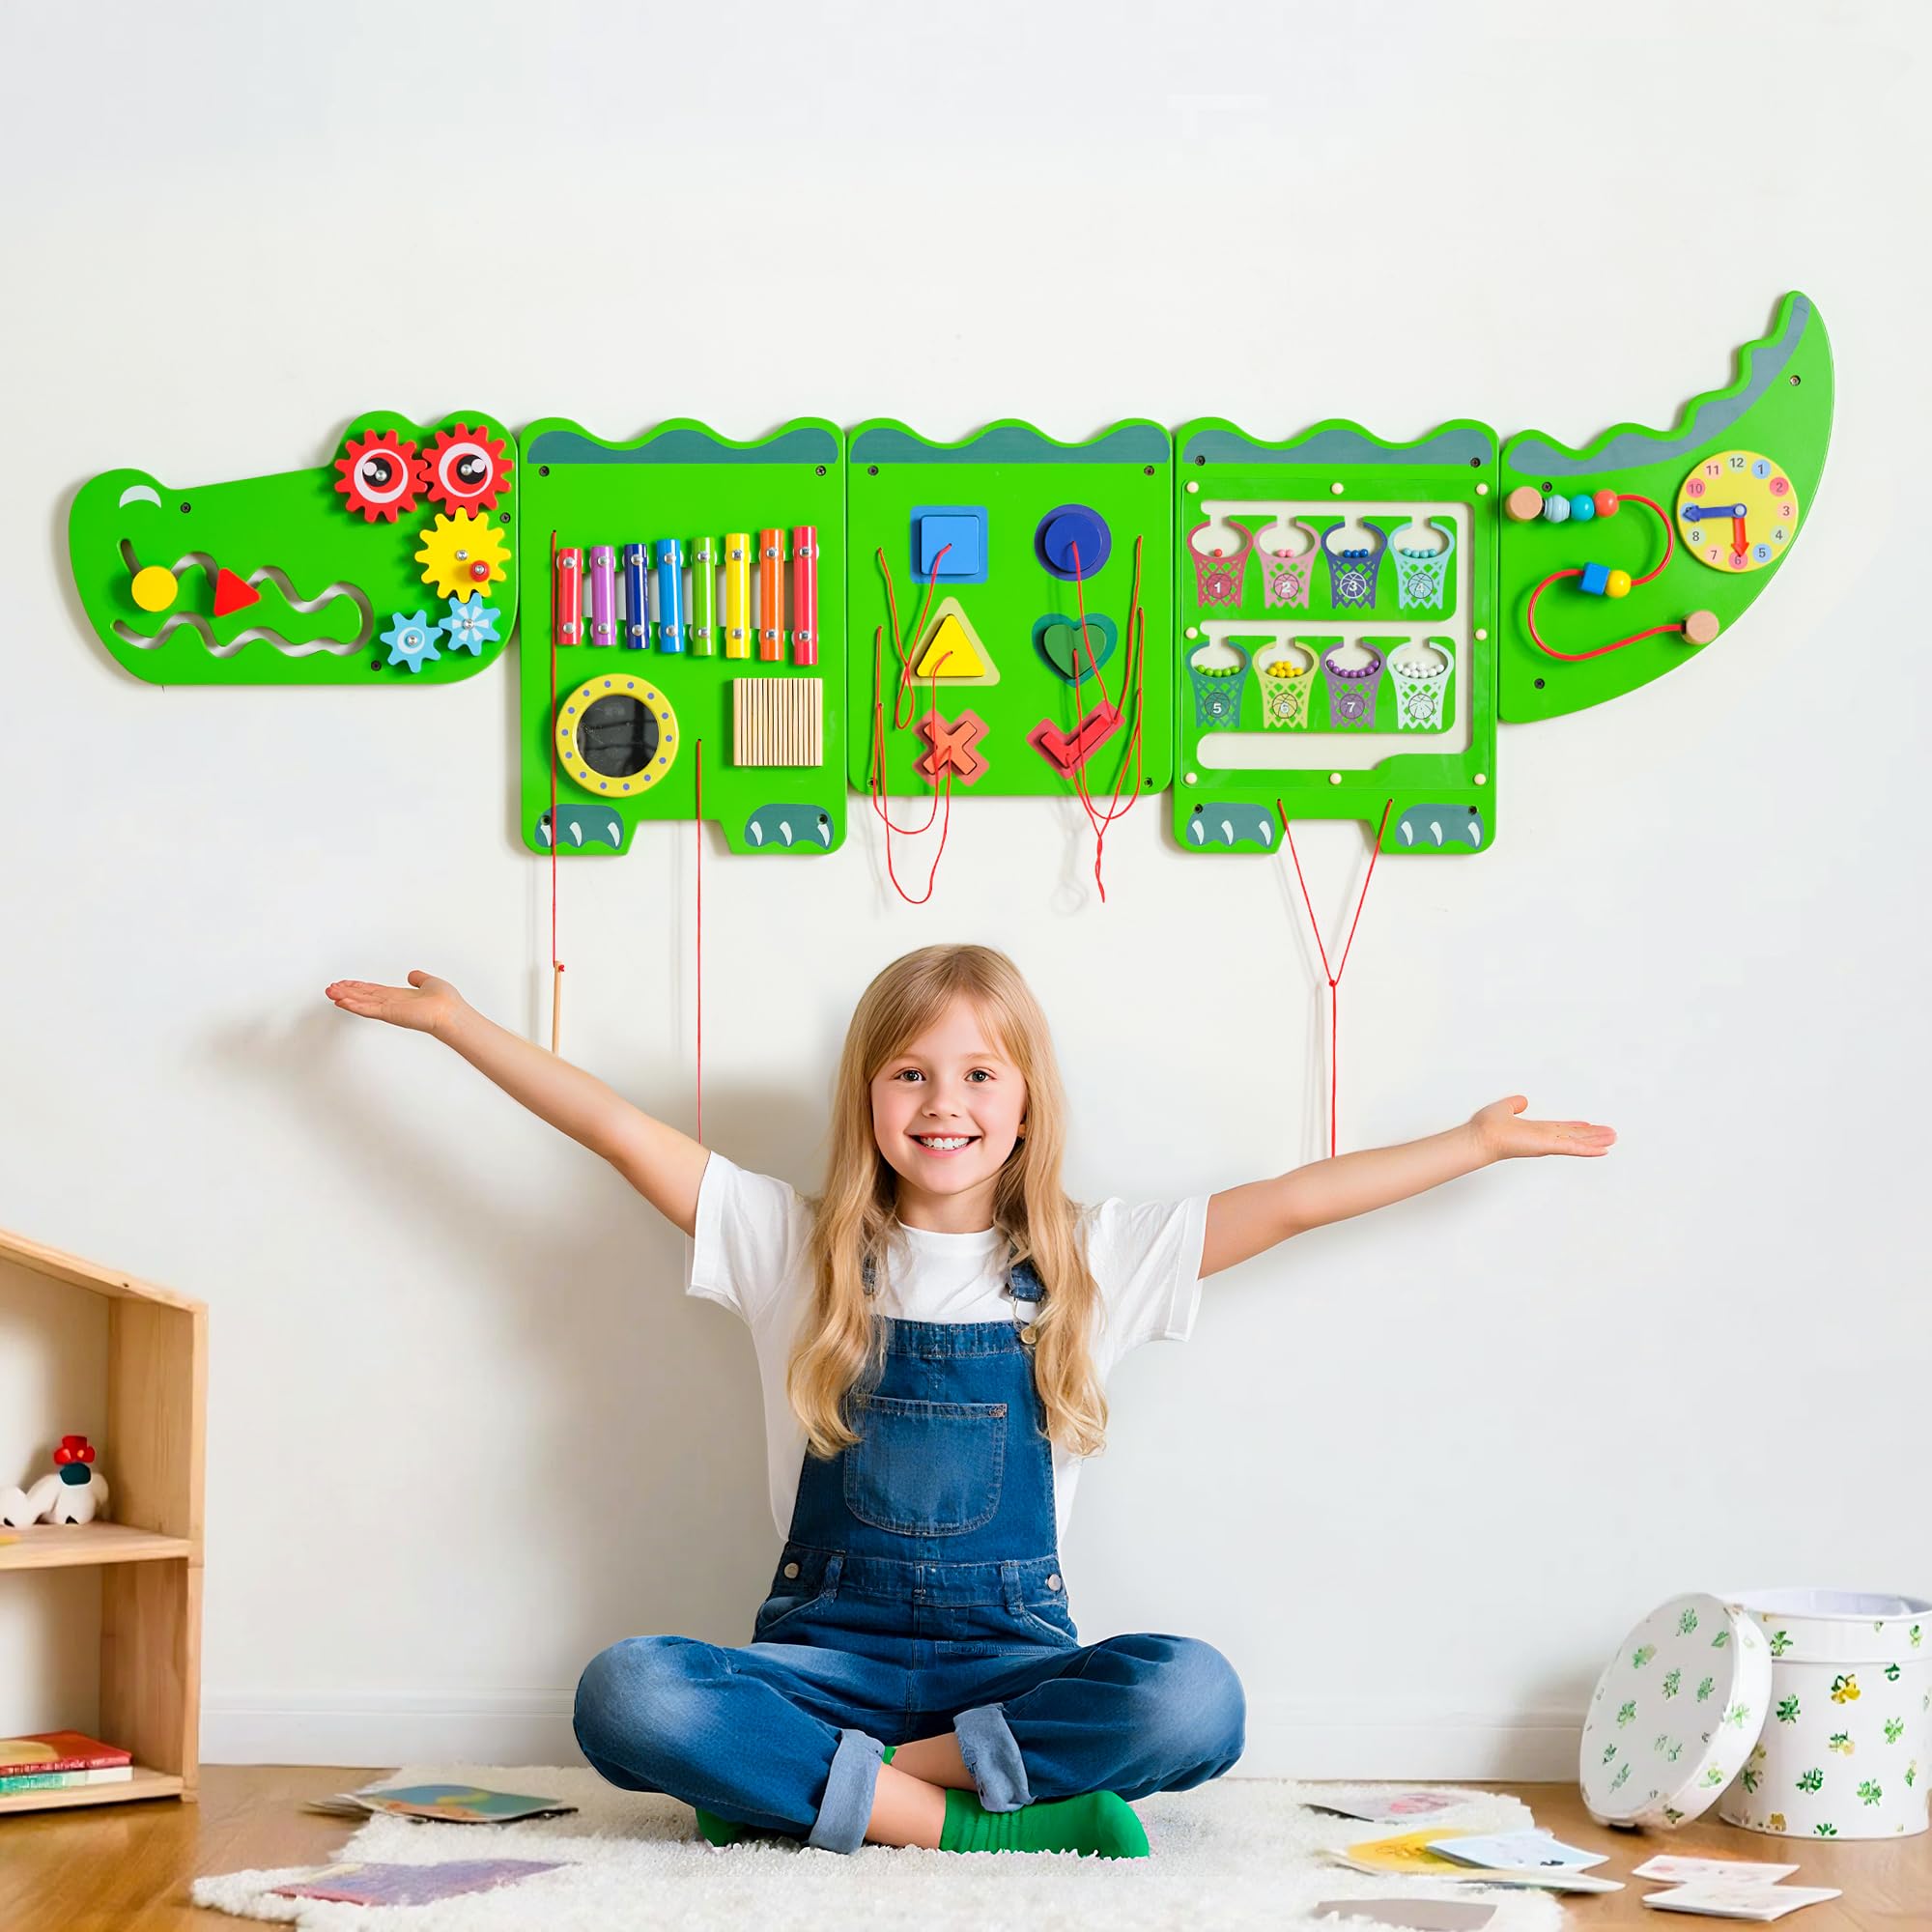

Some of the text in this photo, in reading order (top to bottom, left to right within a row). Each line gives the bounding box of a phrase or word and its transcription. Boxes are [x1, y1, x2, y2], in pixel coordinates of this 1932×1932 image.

[1730, 458, 1744, 468] 12
[1706, 465, 1719, 475] 11
[1758, 465, 1763, 474] 1
[1690, 483, 1702, 494] 10
[1776, 482, 1783, 493] 2
[1783, 505, 1790, 516] 3
[1692, 531, 1699, 541] 8
[1776, 530, 1783, 540] 4
[1711, 550, 1718, 560] 7
[1759, 548, 1766, 557] 5
[1735, 554, 1742, 564] 6
[1214, 582, 1221, 593] 1
[1282, 582, 1291, 593] 2
[1349, 581, 1357, 591] 3
[1416, 582, 1425, 592] 4
[1213, 702, 1222, 713] 5
[1280, 703, 1289, 713] 6
[1347, 702, 1355, 713] 7
